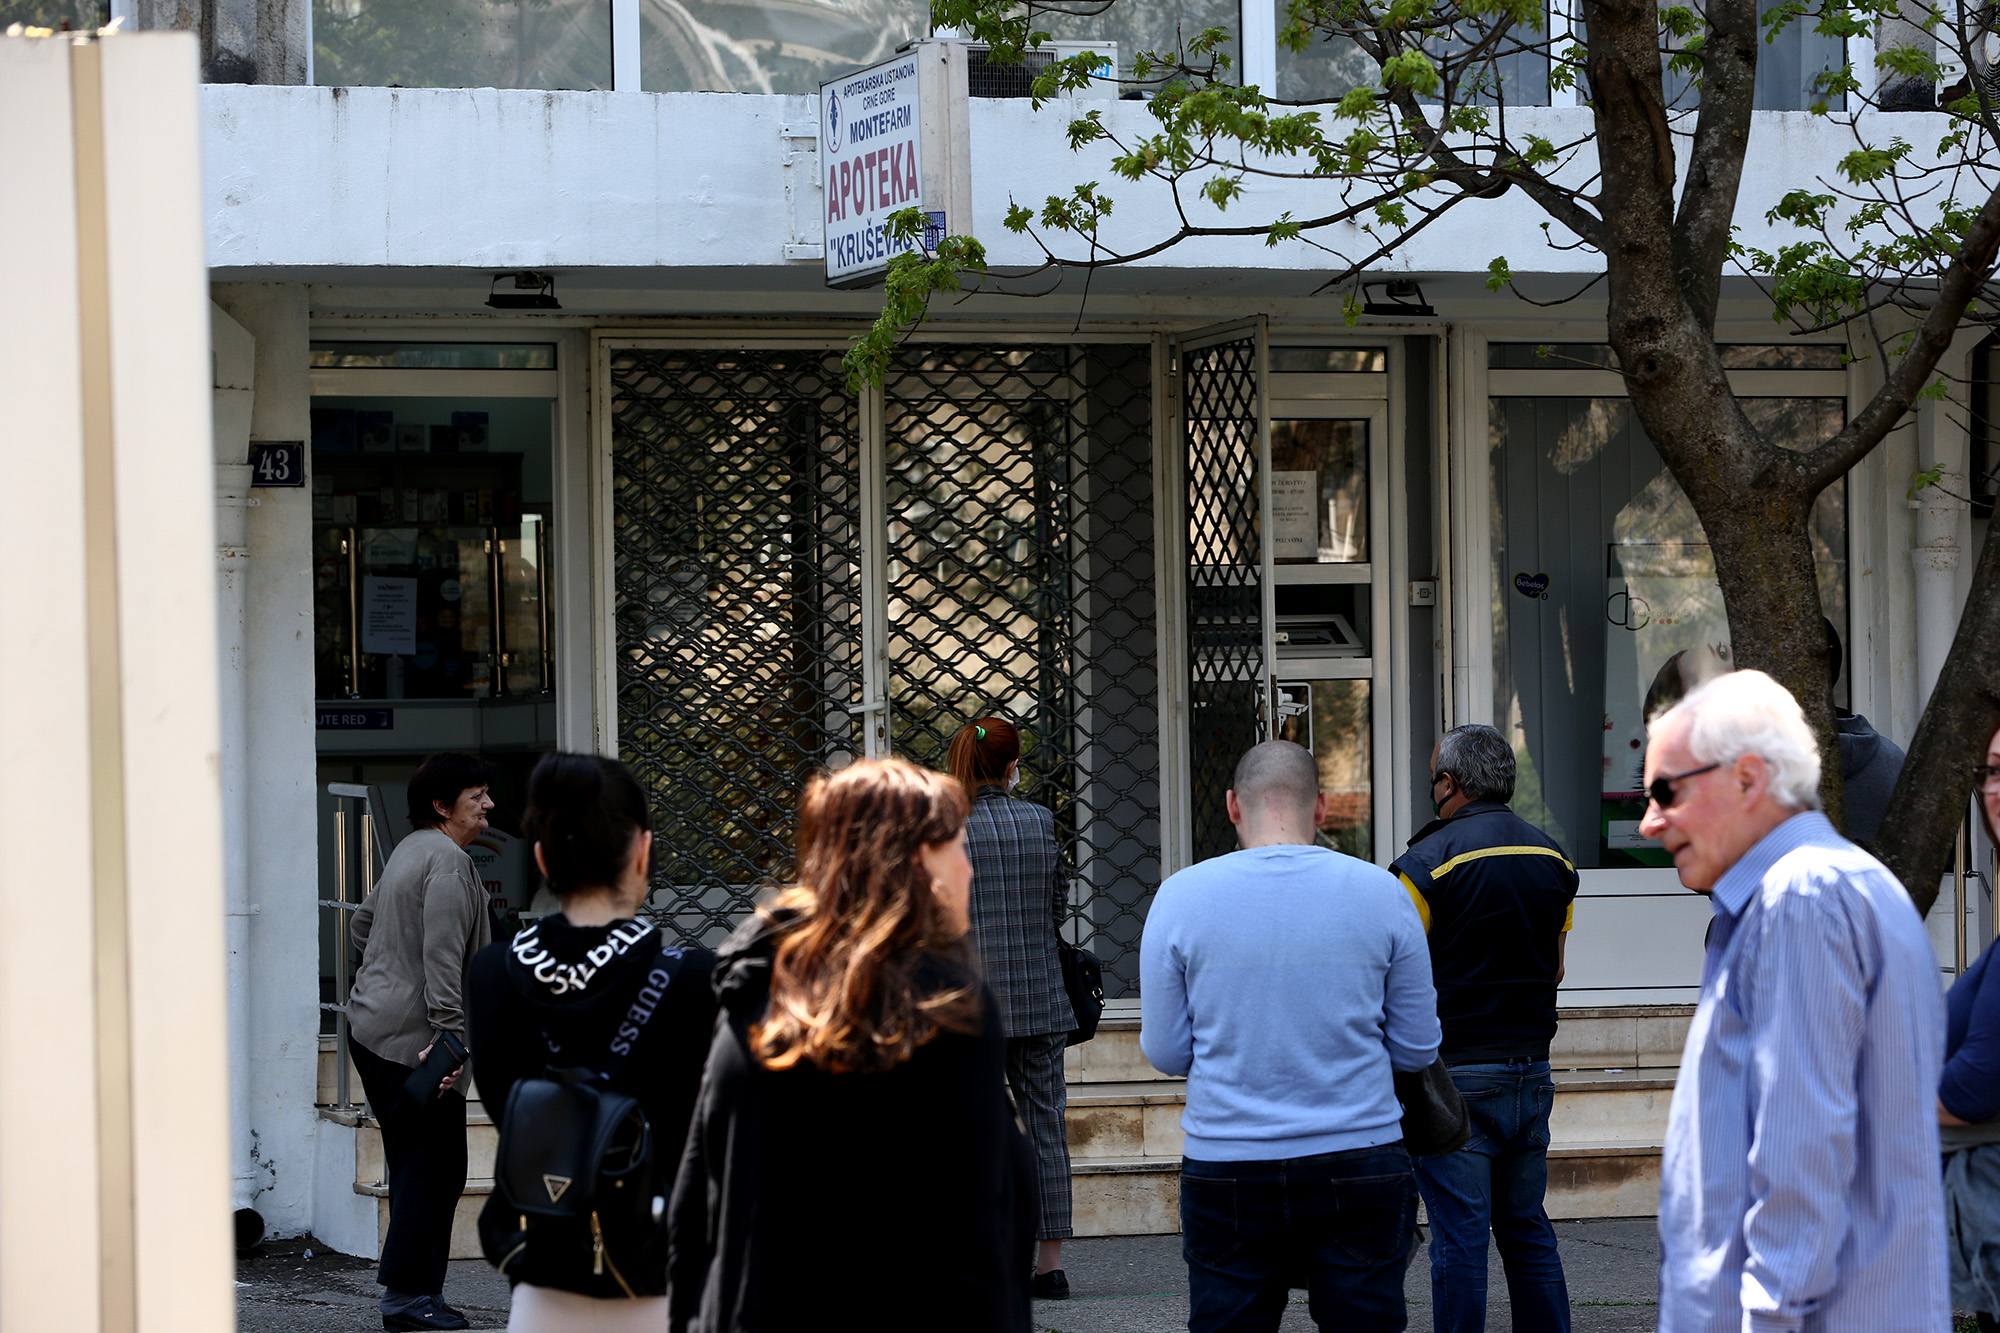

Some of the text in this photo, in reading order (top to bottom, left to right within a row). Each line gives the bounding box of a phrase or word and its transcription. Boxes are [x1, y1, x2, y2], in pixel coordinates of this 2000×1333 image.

[843, 63, 915, 99] APOTEKARSKA USTANOVA
[863, 87, 895, 110] CRNE GORE
[850, 104, 911, 144] MONTEFARM
[828, 140, 919, 223] APOTEKA
[259, 449, 289, 480] 43
[341, 714, 366, 725] RED
[610, 968, 671, 1056] GUESS
